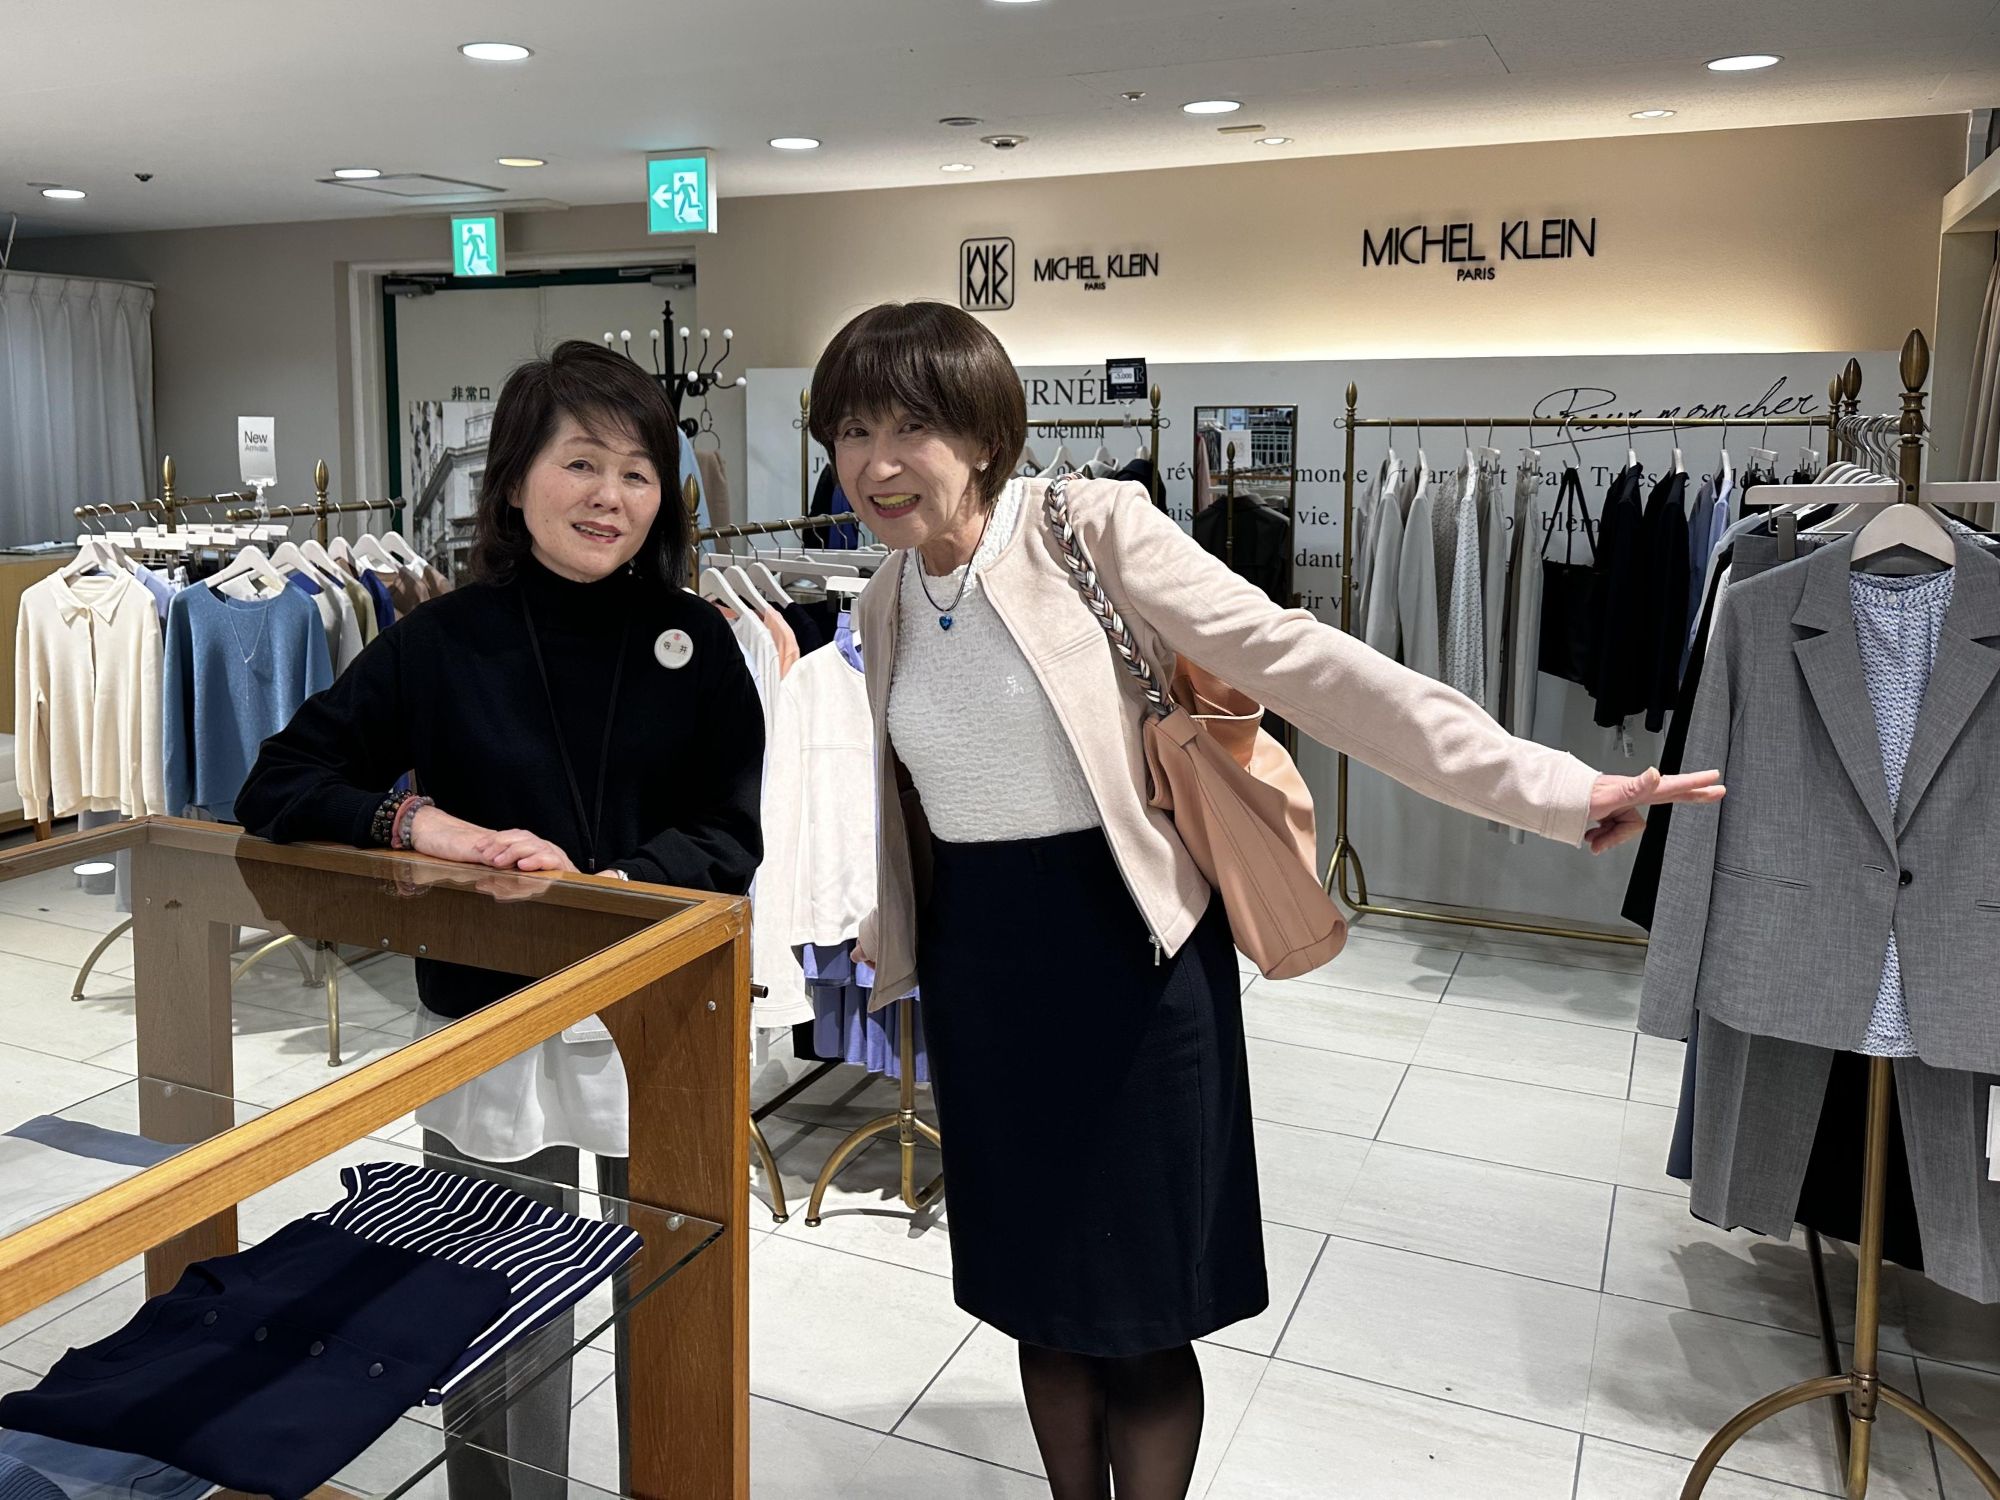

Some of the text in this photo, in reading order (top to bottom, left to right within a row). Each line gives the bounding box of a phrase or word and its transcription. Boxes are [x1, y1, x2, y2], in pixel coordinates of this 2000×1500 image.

[1363, 217, 1596, 267] MICHEL KLEIN
[1034, 252, 1159, 282] MICHEL KLEIN
[1457, 267, 1496, 281] PARIS
[1084, 282, 1106, 291] PARIS
[451, 385, 490, 401] 非常口
[244, 430, 268, 444] New
[1298, 506, 1337, 525] vie.
